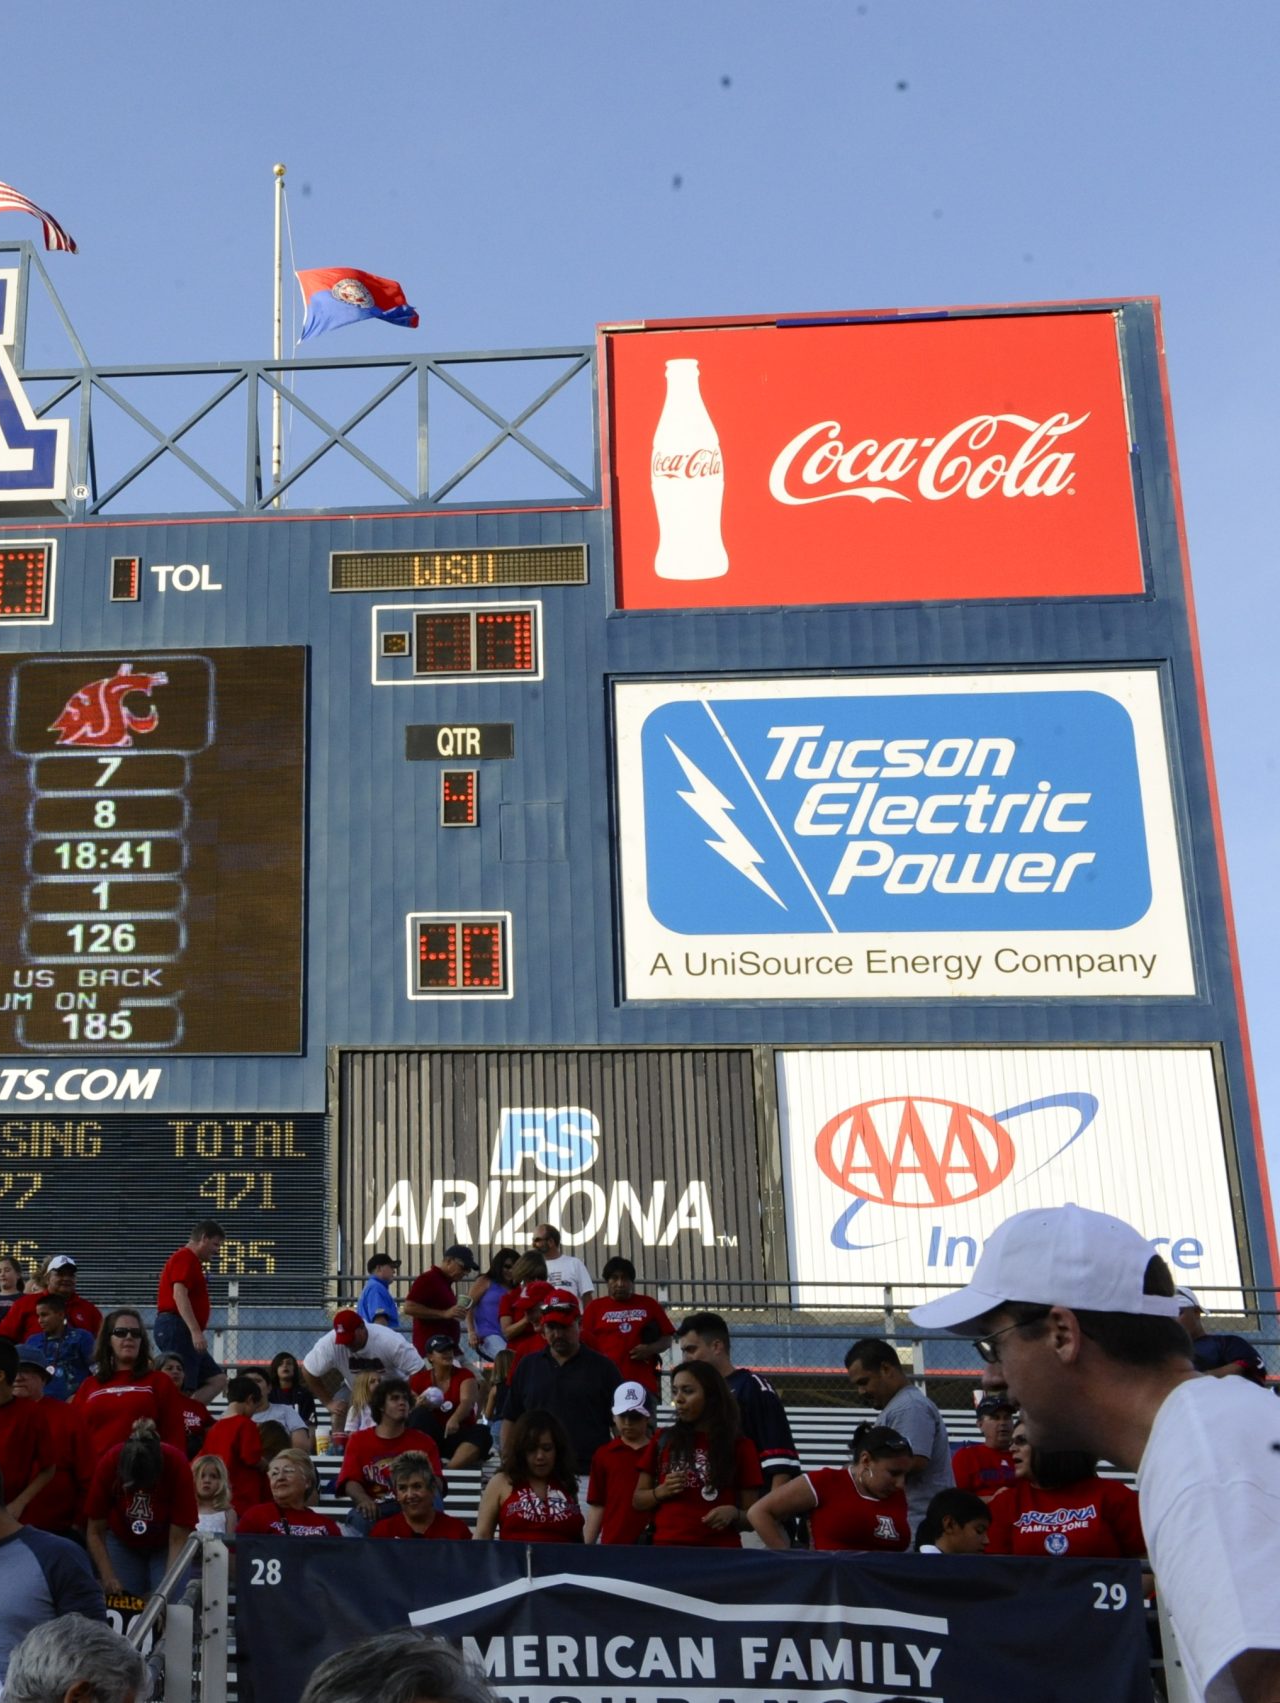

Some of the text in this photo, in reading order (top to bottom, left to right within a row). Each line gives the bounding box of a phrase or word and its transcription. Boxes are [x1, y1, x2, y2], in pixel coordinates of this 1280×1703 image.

[653, 448, 721, 479] Coca-Cola
[769, 411, 1092, 506] Coca-Cola
[151, 564, 222, 592] TOL
[414, 553, 494, 586] WSU
[436, 727, 482, 757] QTR
[765, 725, 1017, 781] Tucson
[94, 758, 123, 788] 7
[444, 774, 475, 822] 4
[793, 781, 1092, 836] Electric
[94, 801, 117, 829] 8
[54, 841, 154, 870] 18:41
[826, 840, 1097, 896] Power
[92, 881, 110, 911] 1
[67, 923, 136, 953] 126
[420, 926, 500, 987] 40
[649, 946, 1158, 981] A UniSource Energy Company
[14, 969, 56, 988] US
[78, 968, 163, 987] BACK
[55, 991, 98, 1010] ON
[62, 1011, 133, 1041] 185
[167, 1120, 308, 1158] TOTAL
[490, 1106, 600, 1177] FS
[839, 1100, 994, 1204] AAA
[199, 1172, 277, 1210] 471
[364, 1178, 716, 1247] ARIZONA
[203, 1240, 277, 1275] 85
[1012, 1503, 1099, 1528] ARIZONA
[250, 1557, 283, 1586] 28
[1092, 1581, 1128, 1612] 29
[461, 1634, 944, 1690] MERICAN FAMILY
